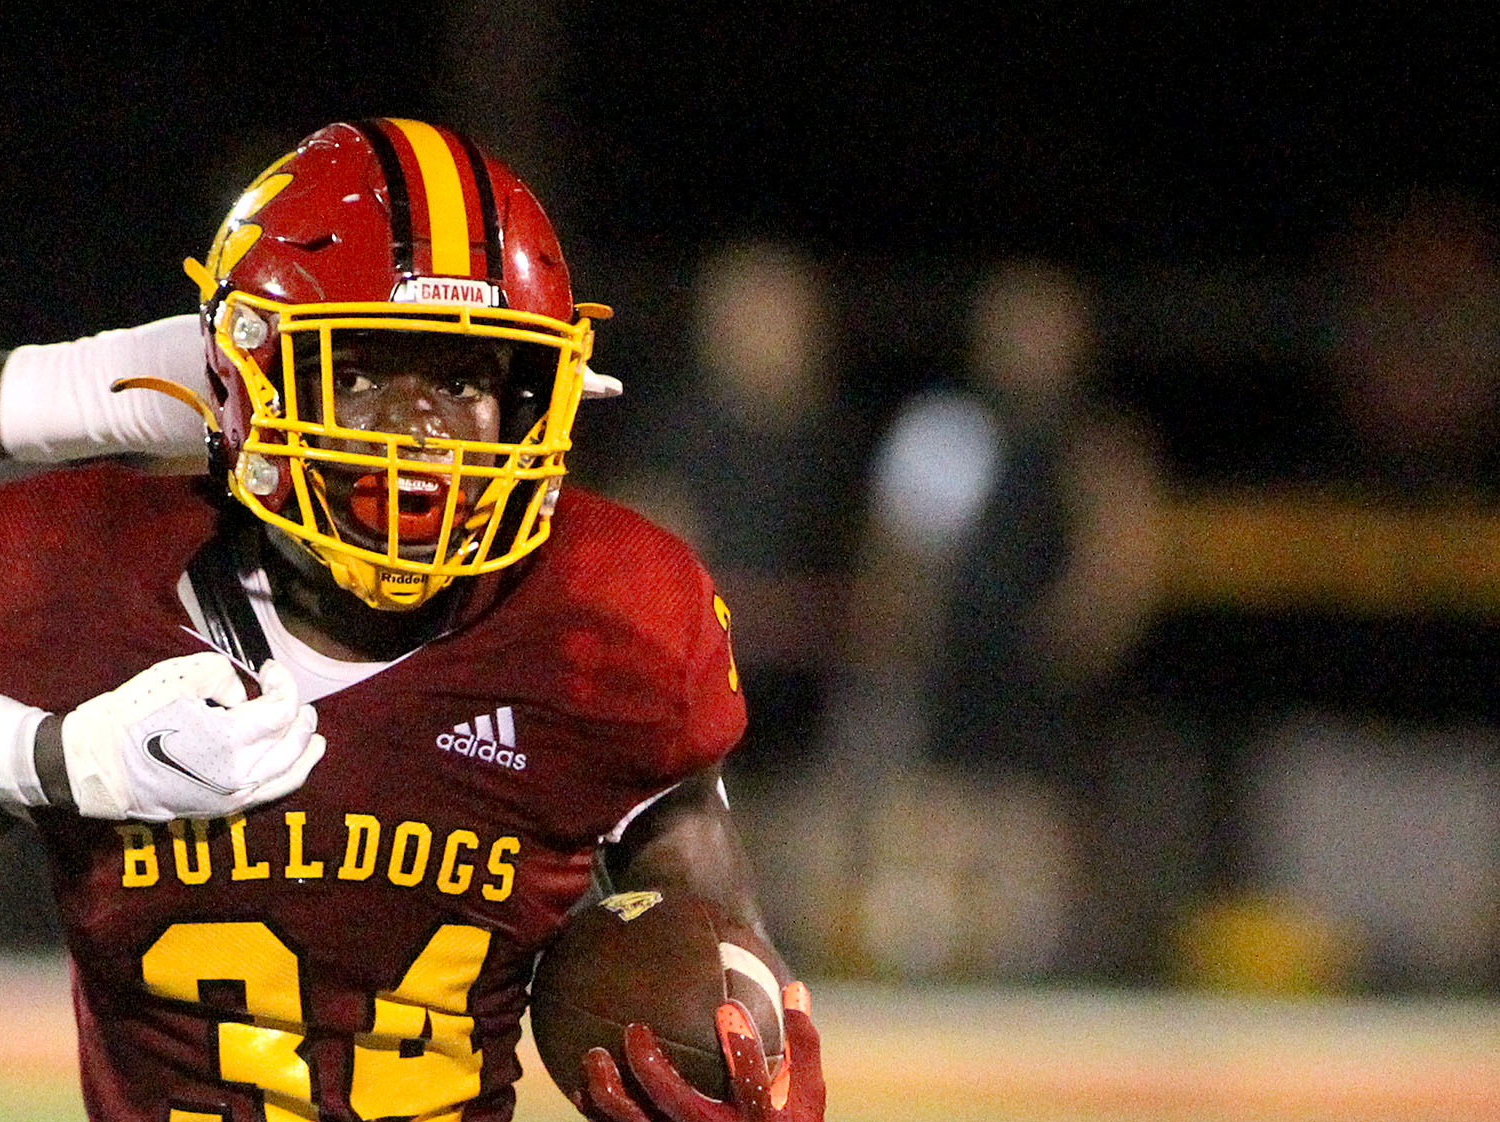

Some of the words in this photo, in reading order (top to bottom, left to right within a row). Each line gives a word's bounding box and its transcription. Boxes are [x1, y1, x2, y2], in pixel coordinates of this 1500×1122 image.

[421, 283, 484, 303] BATAVIA
[436, 733, 527, 770] adidas
[115, 809, 522, 902] BULLDOGS
